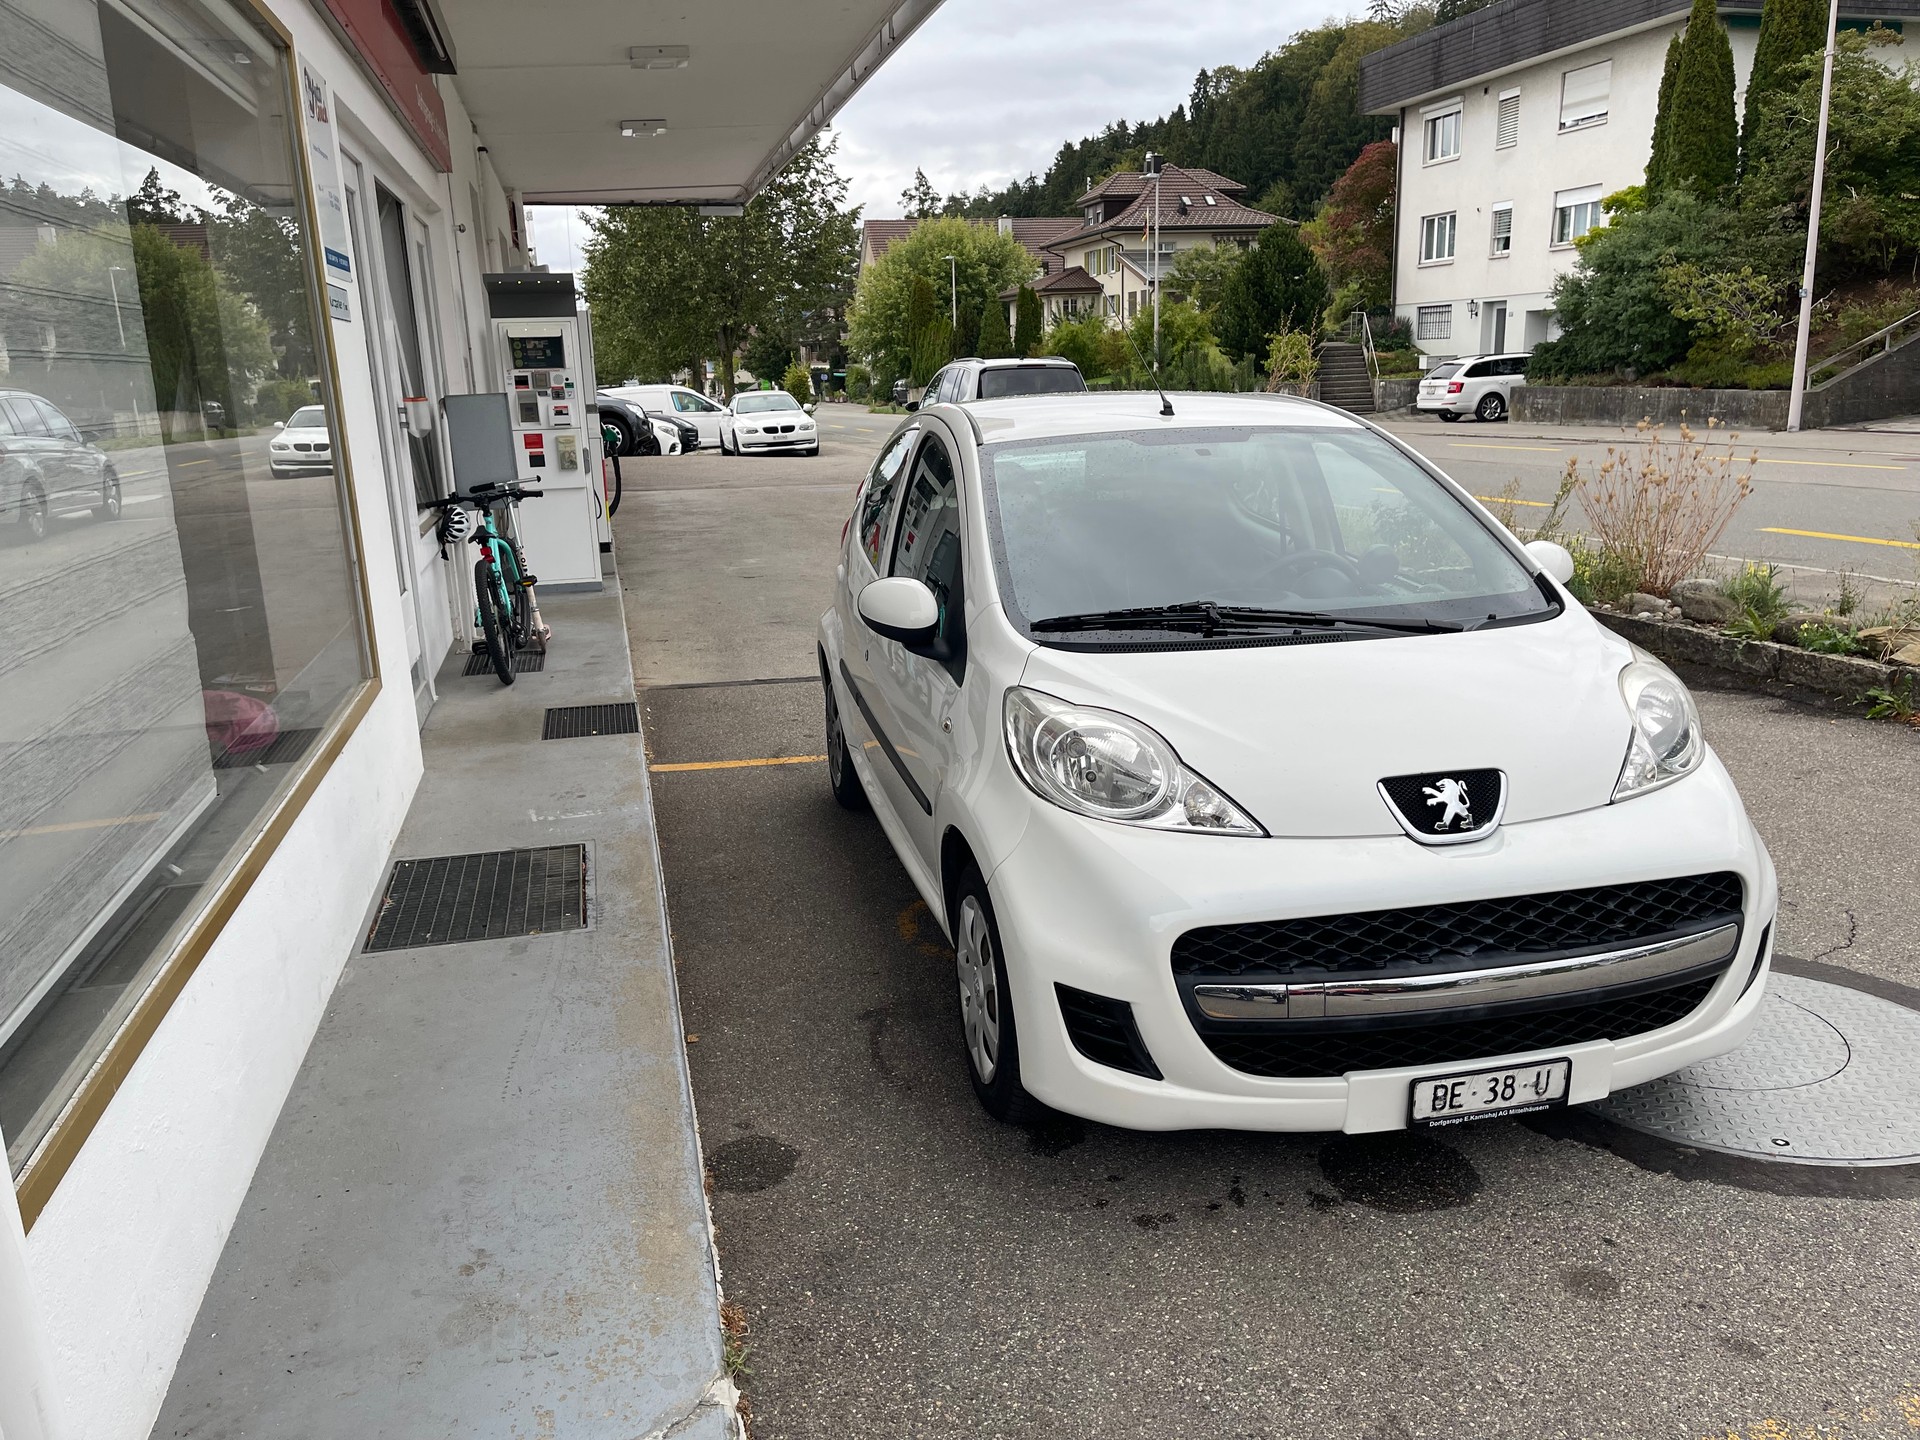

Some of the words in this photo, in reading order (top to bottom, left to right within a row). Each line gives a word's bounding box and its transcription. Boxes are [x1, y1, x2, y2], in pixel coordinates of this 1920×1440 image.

[1431, 1081, 1466, 1112] BE
[1483, 1075, 1516, 1104] 38
[1533, 1069, 1551, 1096] U
[1429, 1117, 1463, 1127] Dorfgarage
[1509, 1104, 1549, 1115] Mittelhäusern
